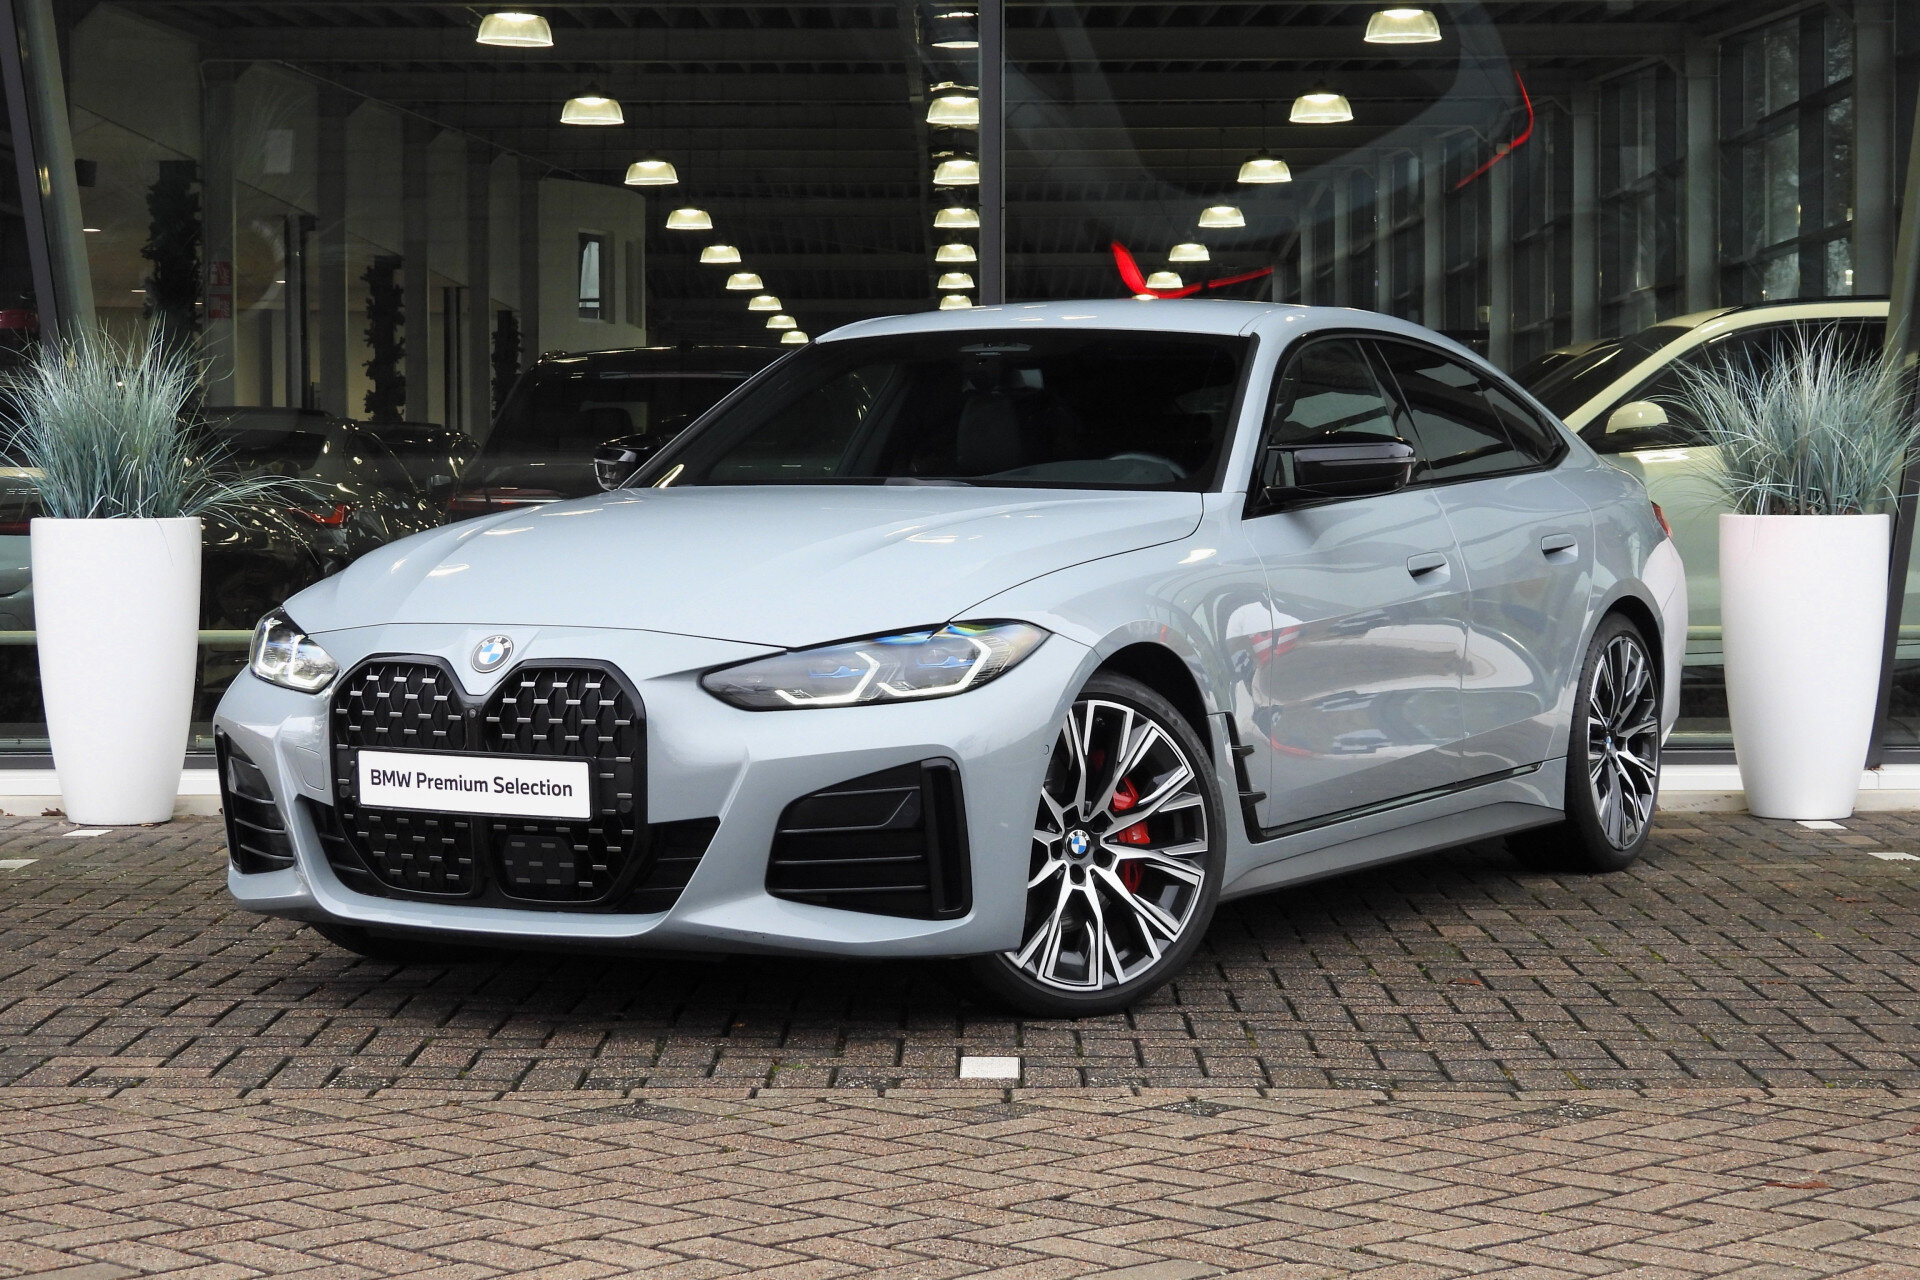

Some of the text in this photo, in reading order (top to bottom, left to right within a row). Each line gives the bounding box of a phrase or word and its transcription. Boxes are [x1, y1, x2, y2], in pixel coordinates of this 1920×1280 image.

[370, 768, 573, 797] BMW Premium Selection
